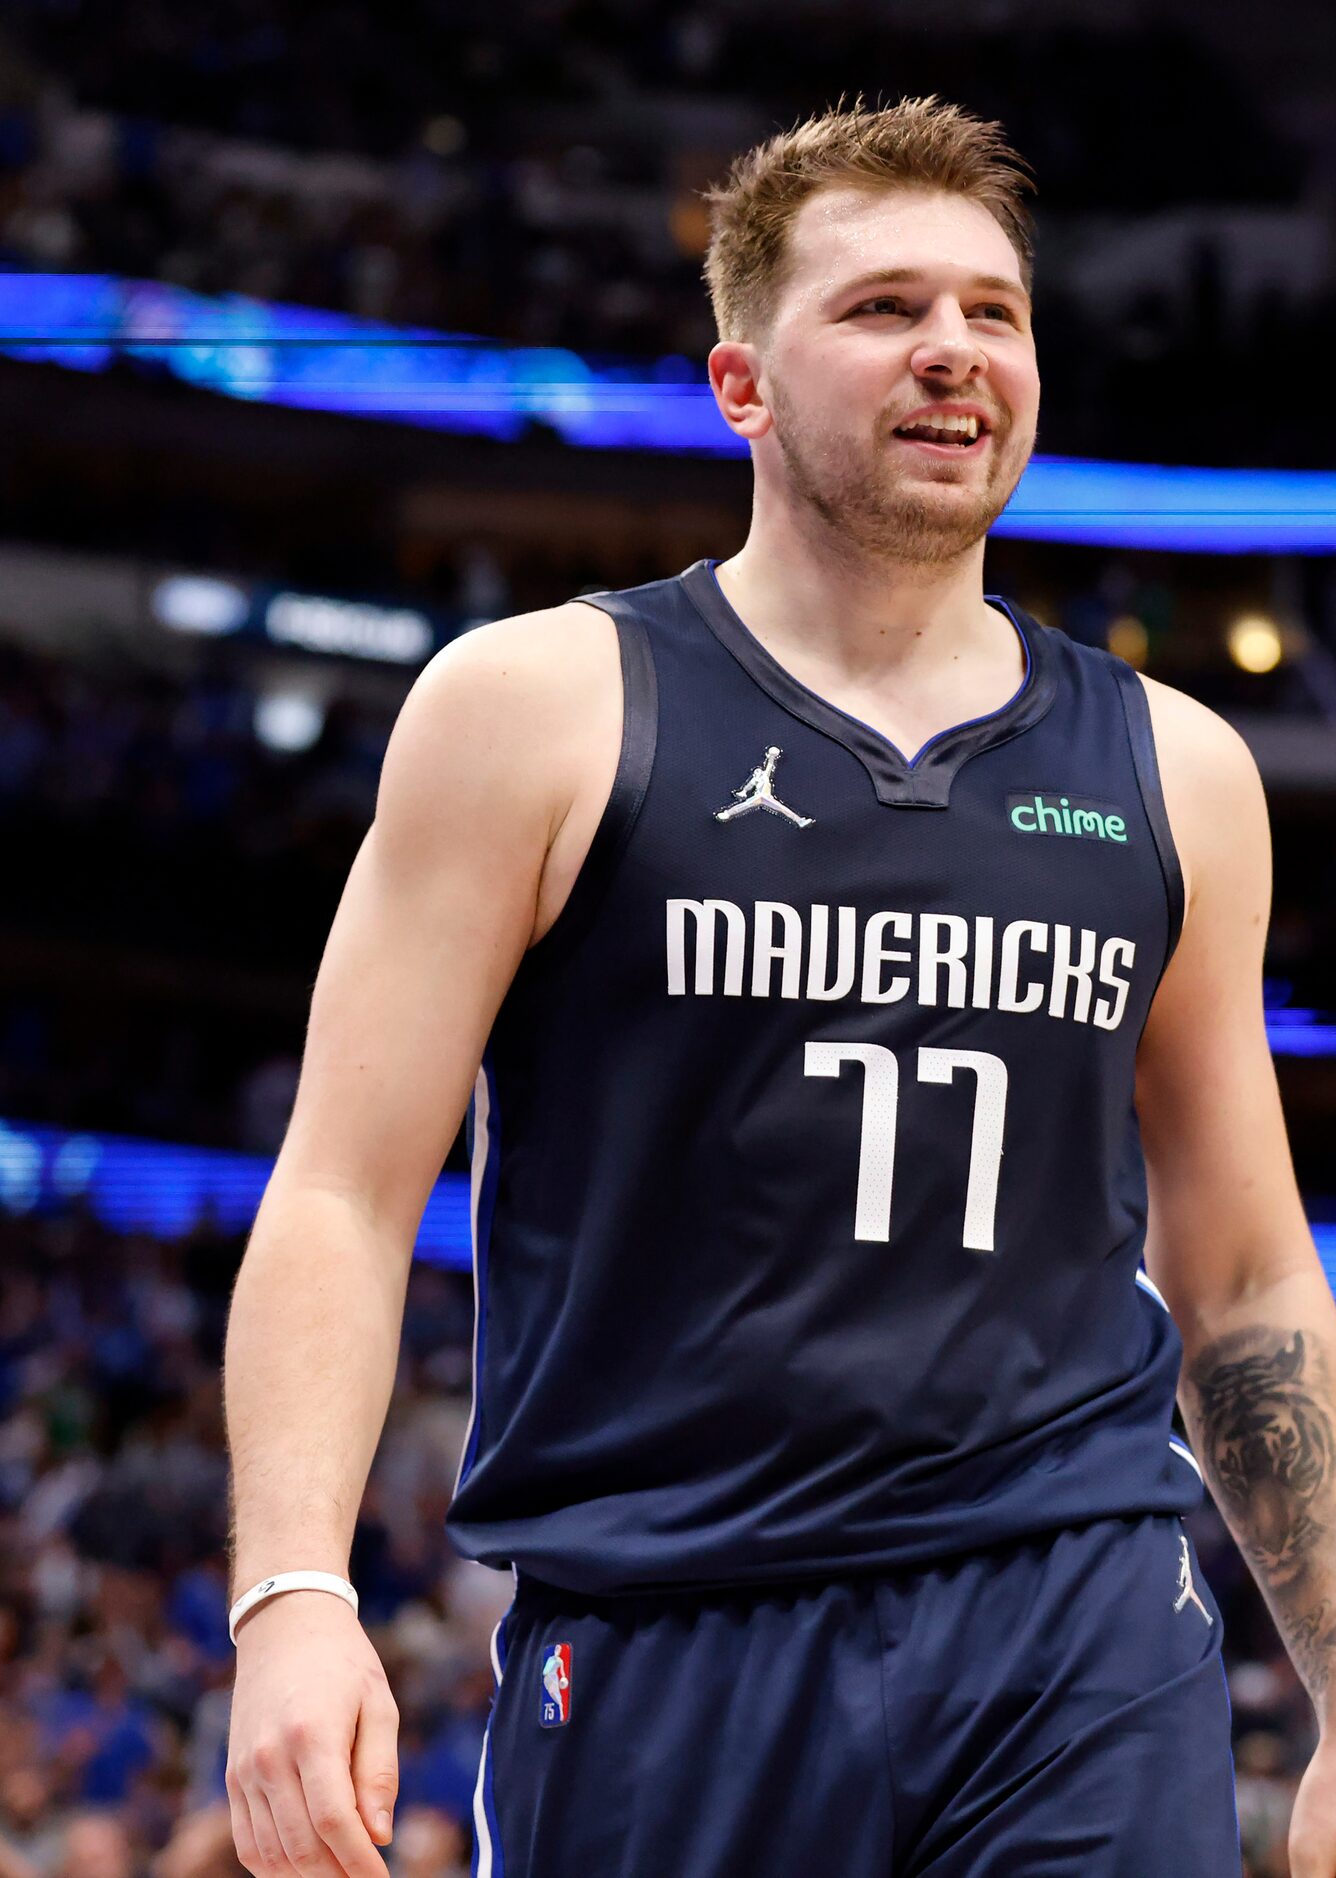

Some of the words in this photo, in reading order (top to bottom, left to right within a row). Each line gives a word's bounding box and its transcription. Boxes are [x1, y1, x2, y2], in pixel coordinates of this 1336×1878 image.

[1011, 796, 1128, 842] chime
[666, 898, 1136, 1031] MAVERICKS
[804, 1041, 1009, 1251] 77
[544, 1703, 555, 1720] 75
